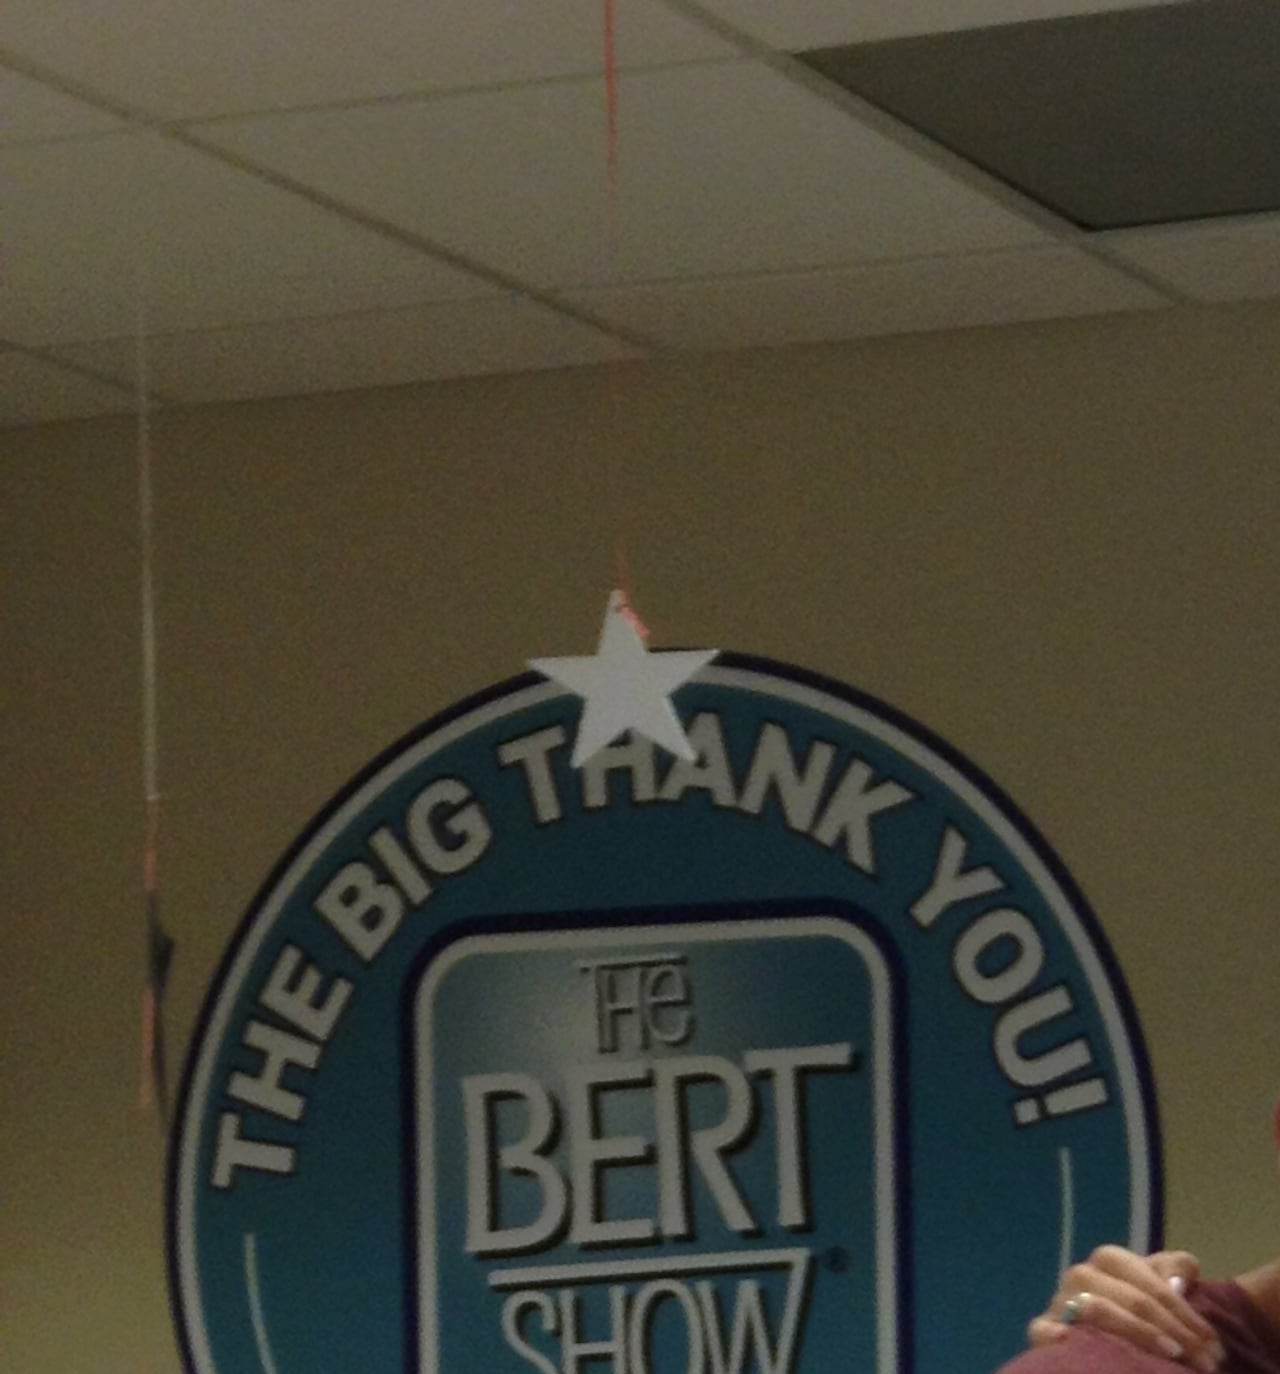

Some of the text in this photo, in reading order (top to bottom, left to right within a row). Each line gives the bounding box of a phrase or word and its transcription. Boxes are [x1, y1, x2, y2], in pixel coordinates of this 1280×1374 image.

[211, 711, 1110, 1189] THE BIG THANK YOU!
[460, 1042, 857, 1259] BERT
